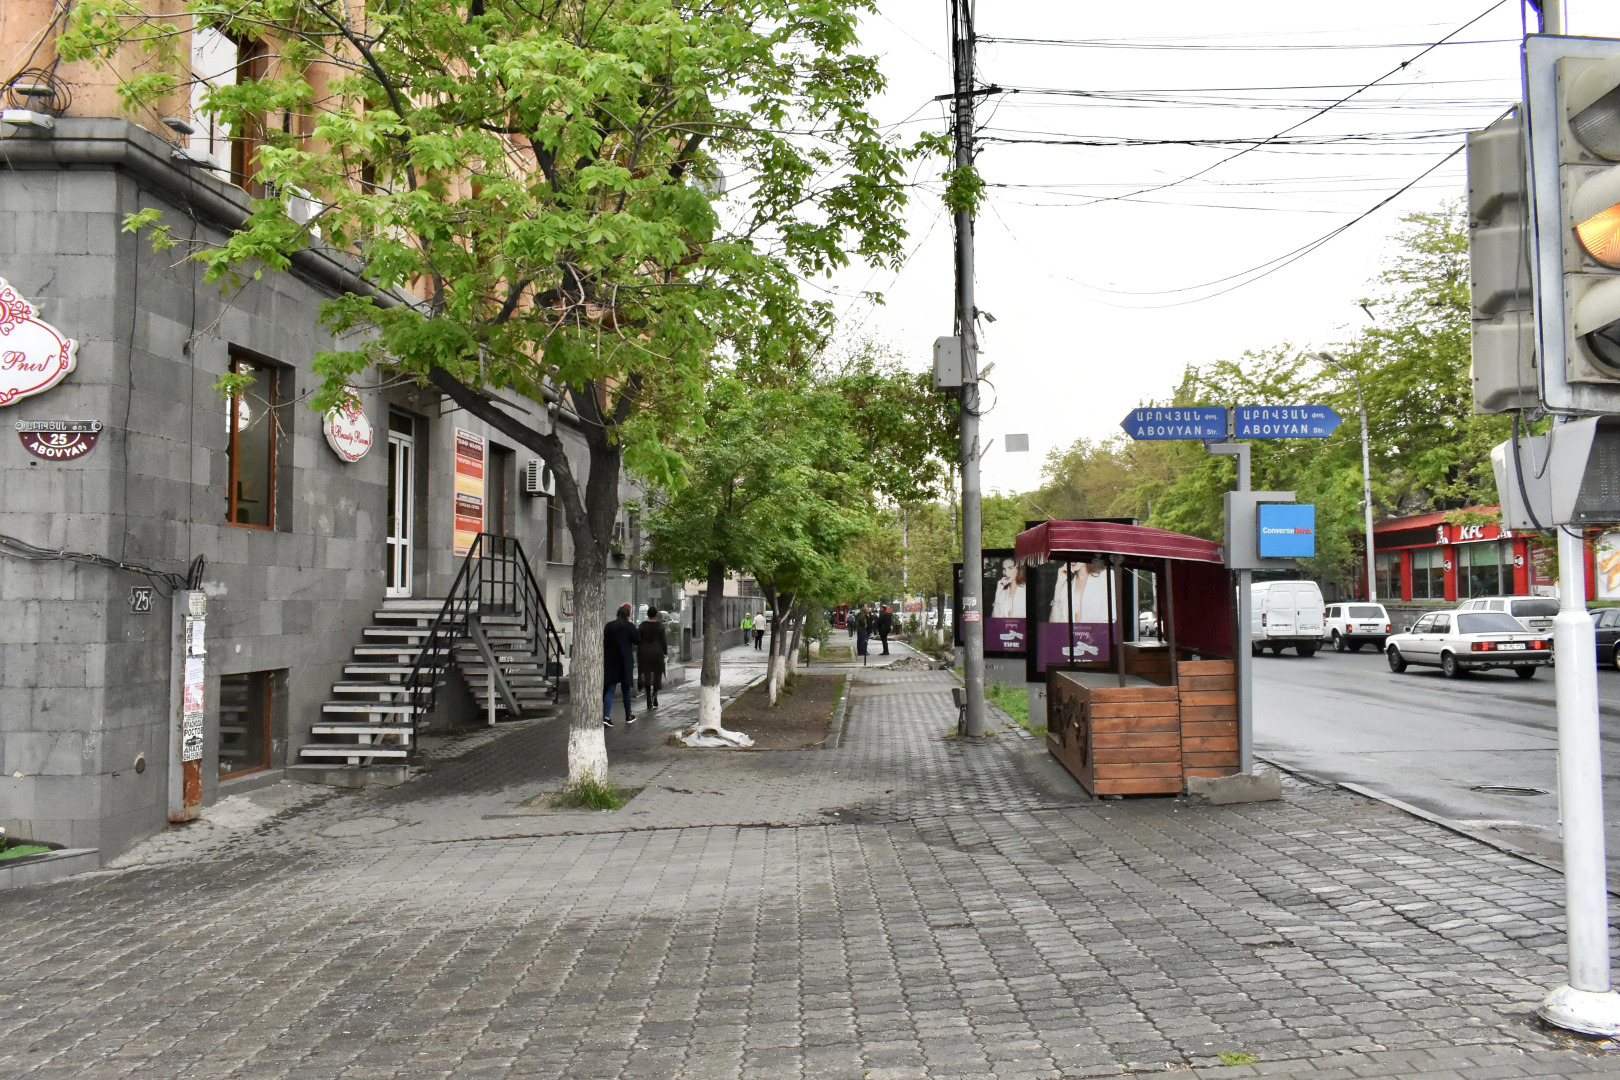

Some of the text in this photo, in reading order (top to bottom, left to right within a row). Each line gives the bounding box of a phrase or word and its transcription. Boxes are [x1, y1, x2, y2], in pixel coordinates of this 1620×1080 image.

[1137, 411, 1201, 421] ԱԲՈՎՅԱՆ
[1243, 409, 1308, 420] ԱԲՈՎՅԱՆ
[335, 424, 354, 446] Beauty
[1137, 425, 1202, 436] ABOVYAN
[1243, 424, 1309, 434] ABOVYAN
[50, 433, 67, 445] 25
[30, 441, 88, 458] ABOVYAN
[1460, 524, 1484, 541] KFC
[135, 590, 149, 611] 25
